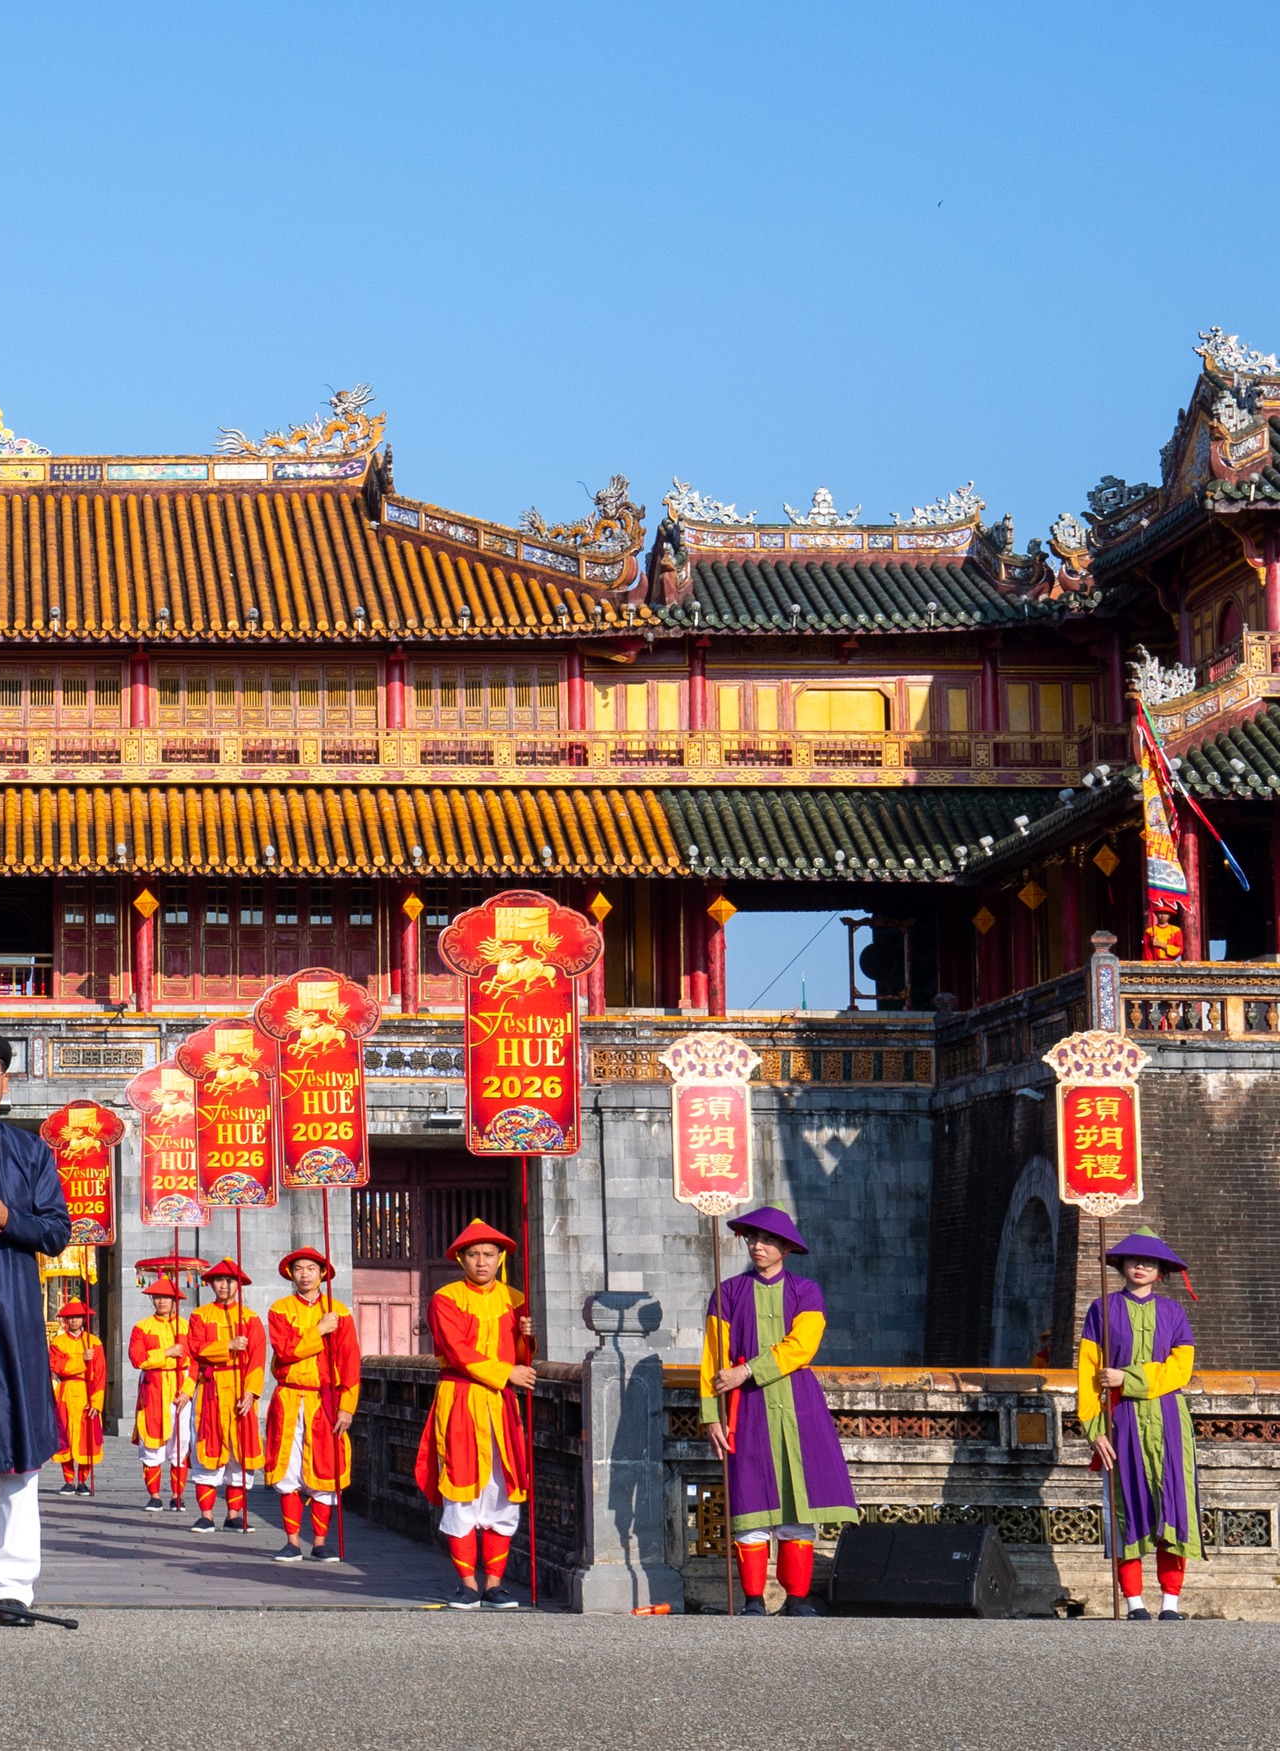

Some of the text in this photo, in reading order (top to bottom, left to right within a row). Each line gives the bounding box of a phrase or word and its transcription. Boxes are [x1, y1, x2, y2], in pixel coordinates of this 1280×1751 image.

[470, 994, 572, 1047] Festival
[281, 1054, 360, 1100] Festival
[482, 1075, 563, 1099] 2026
[197, 1093, 271, 1131] Festival
[144, 1124, 196, 1158] Festiv
[292, 1121, 354, 1142] 2026
[206, 1151, 265, 1168] 2026
[66, 1201, 105, 1215] 2026
